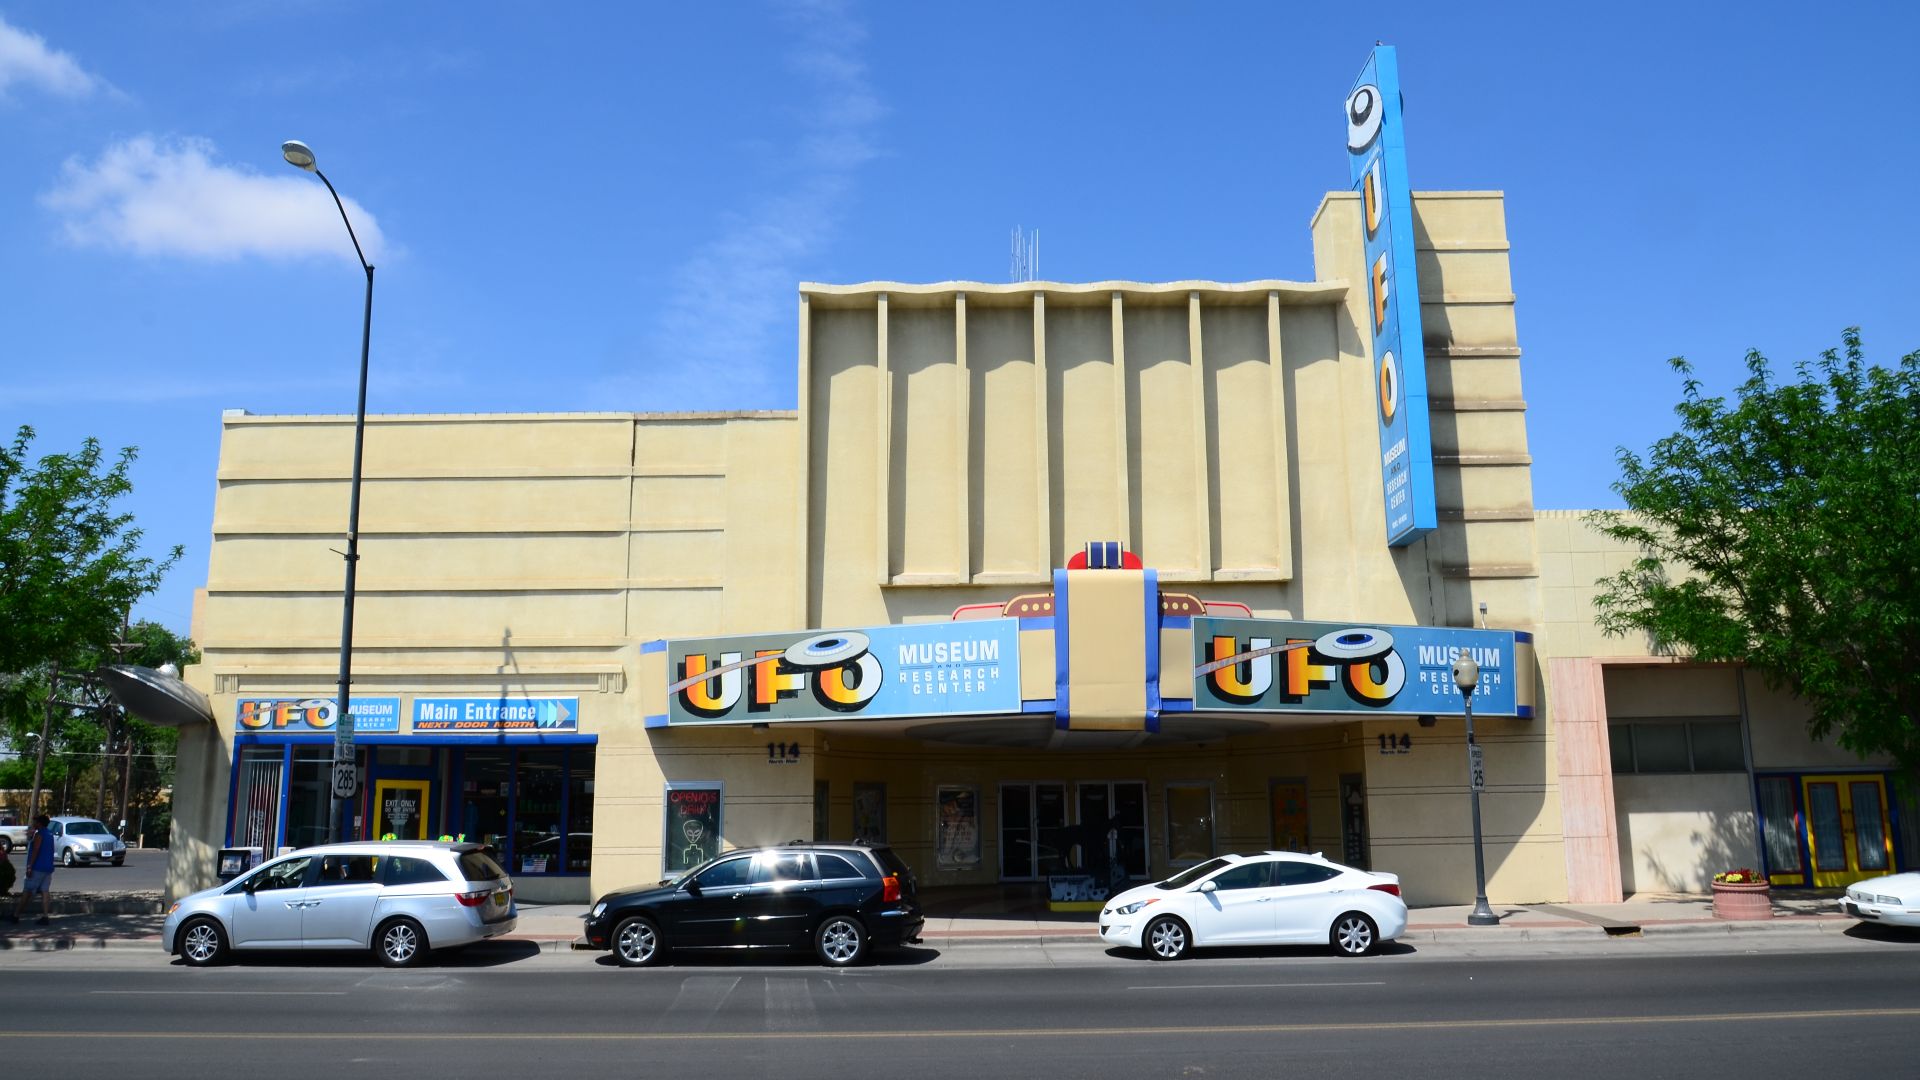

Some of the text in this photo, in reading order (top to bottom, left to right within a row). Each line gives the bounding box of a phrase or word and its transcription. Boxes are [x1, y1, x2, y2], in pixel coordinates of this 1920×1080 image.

[1363, 158, 1398, 424] UFO
[1384, 437, 1406, 467] MUSEUM
[899, 639, 999, 665] MUSEUM
[1419, 645, 1500, 667] MUSUM
[899, 667, 999, 684] RESEARCH
[1205, 636, 1406, 706] UFO
[1420, 671, 1501, 684] RESCH
[678, 649, 883, 717] UFO
[913, 681, 985, 695] CENTER
[1432, 684, 1491, 696] CENER
[240, 700, 338, 730] UFO
[348, 704, 393, 715] MUSEUM
[420, 703, 536, 720] Main Entrance
[418, 721, 535, 729] NEXT DOOR NORTH
[1378, 733, 1412, 749] 114
[768, 743, 801, 758] 114
[337, 769, 354, 790] 285
[1474, 769, 1483, 786] 25
[385, 799, 416, 807] EXIT ONLY
